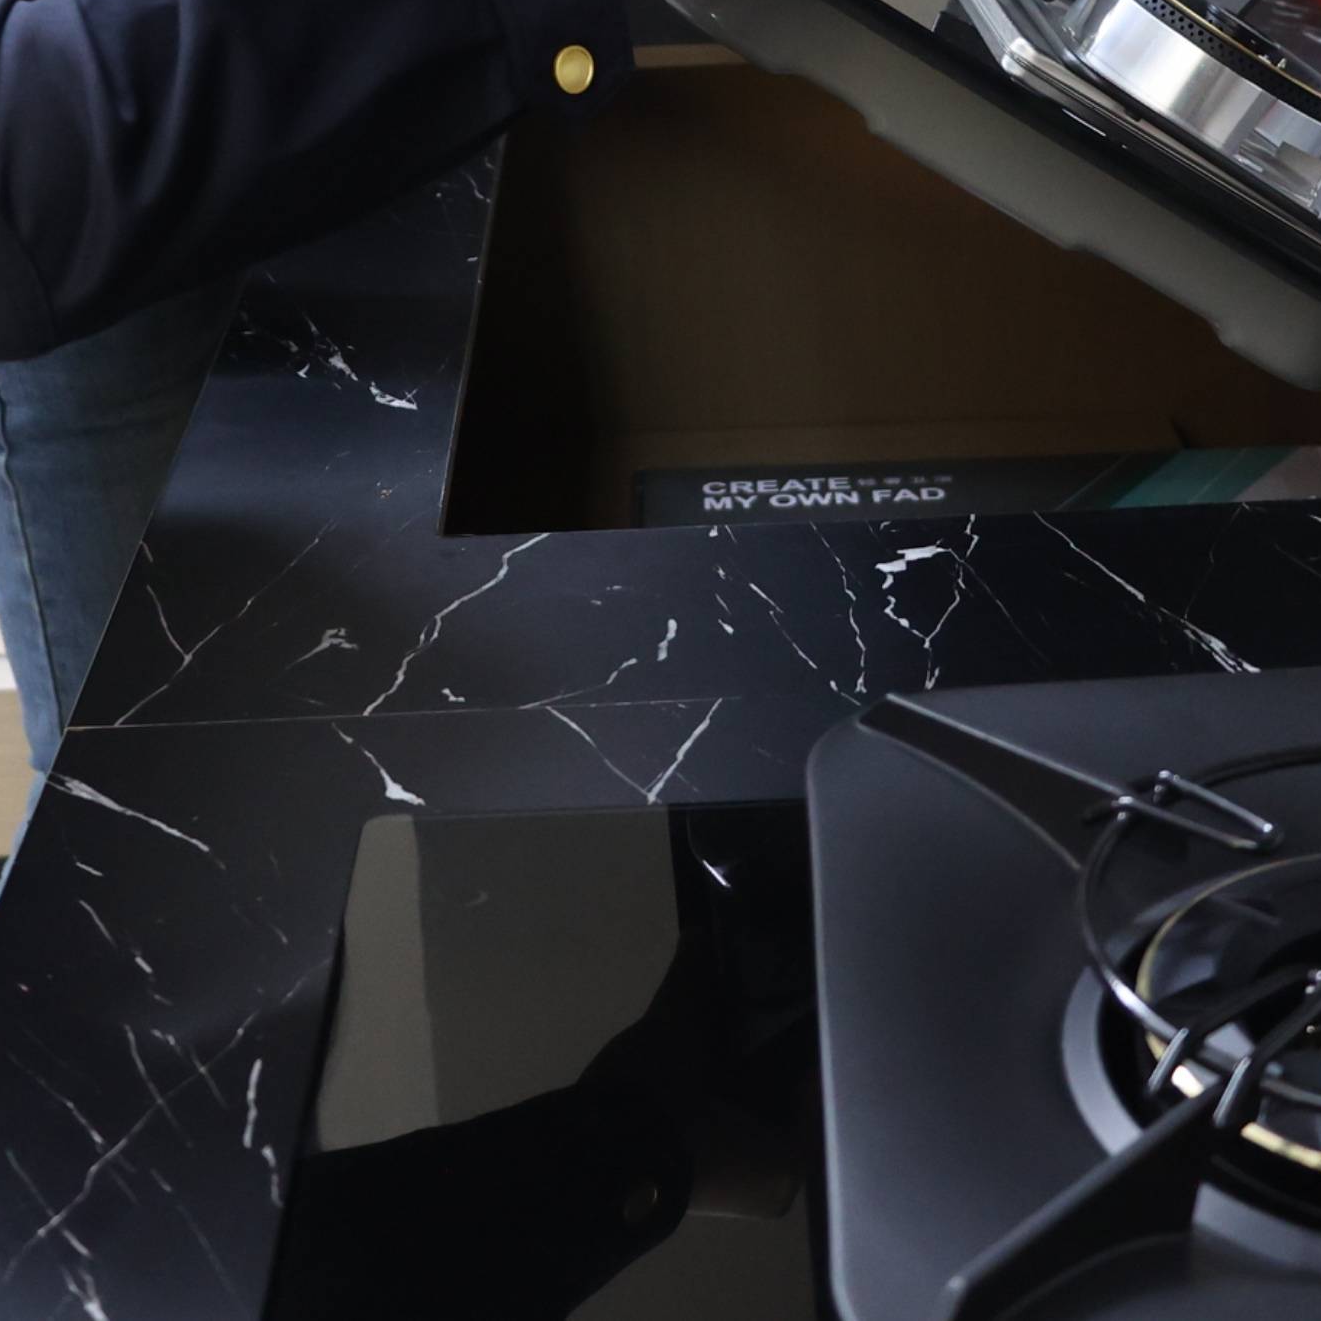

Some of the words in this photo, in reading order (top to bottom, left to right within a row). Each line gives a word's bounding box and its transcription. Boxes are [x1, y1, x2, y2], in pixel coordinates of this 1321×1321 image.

[701, 477, 852, 496] CREATE
[703, 494, 758, 512] MY
[769, 491, 861, 509] OWN
[872, 486, 947, 504] FAD
